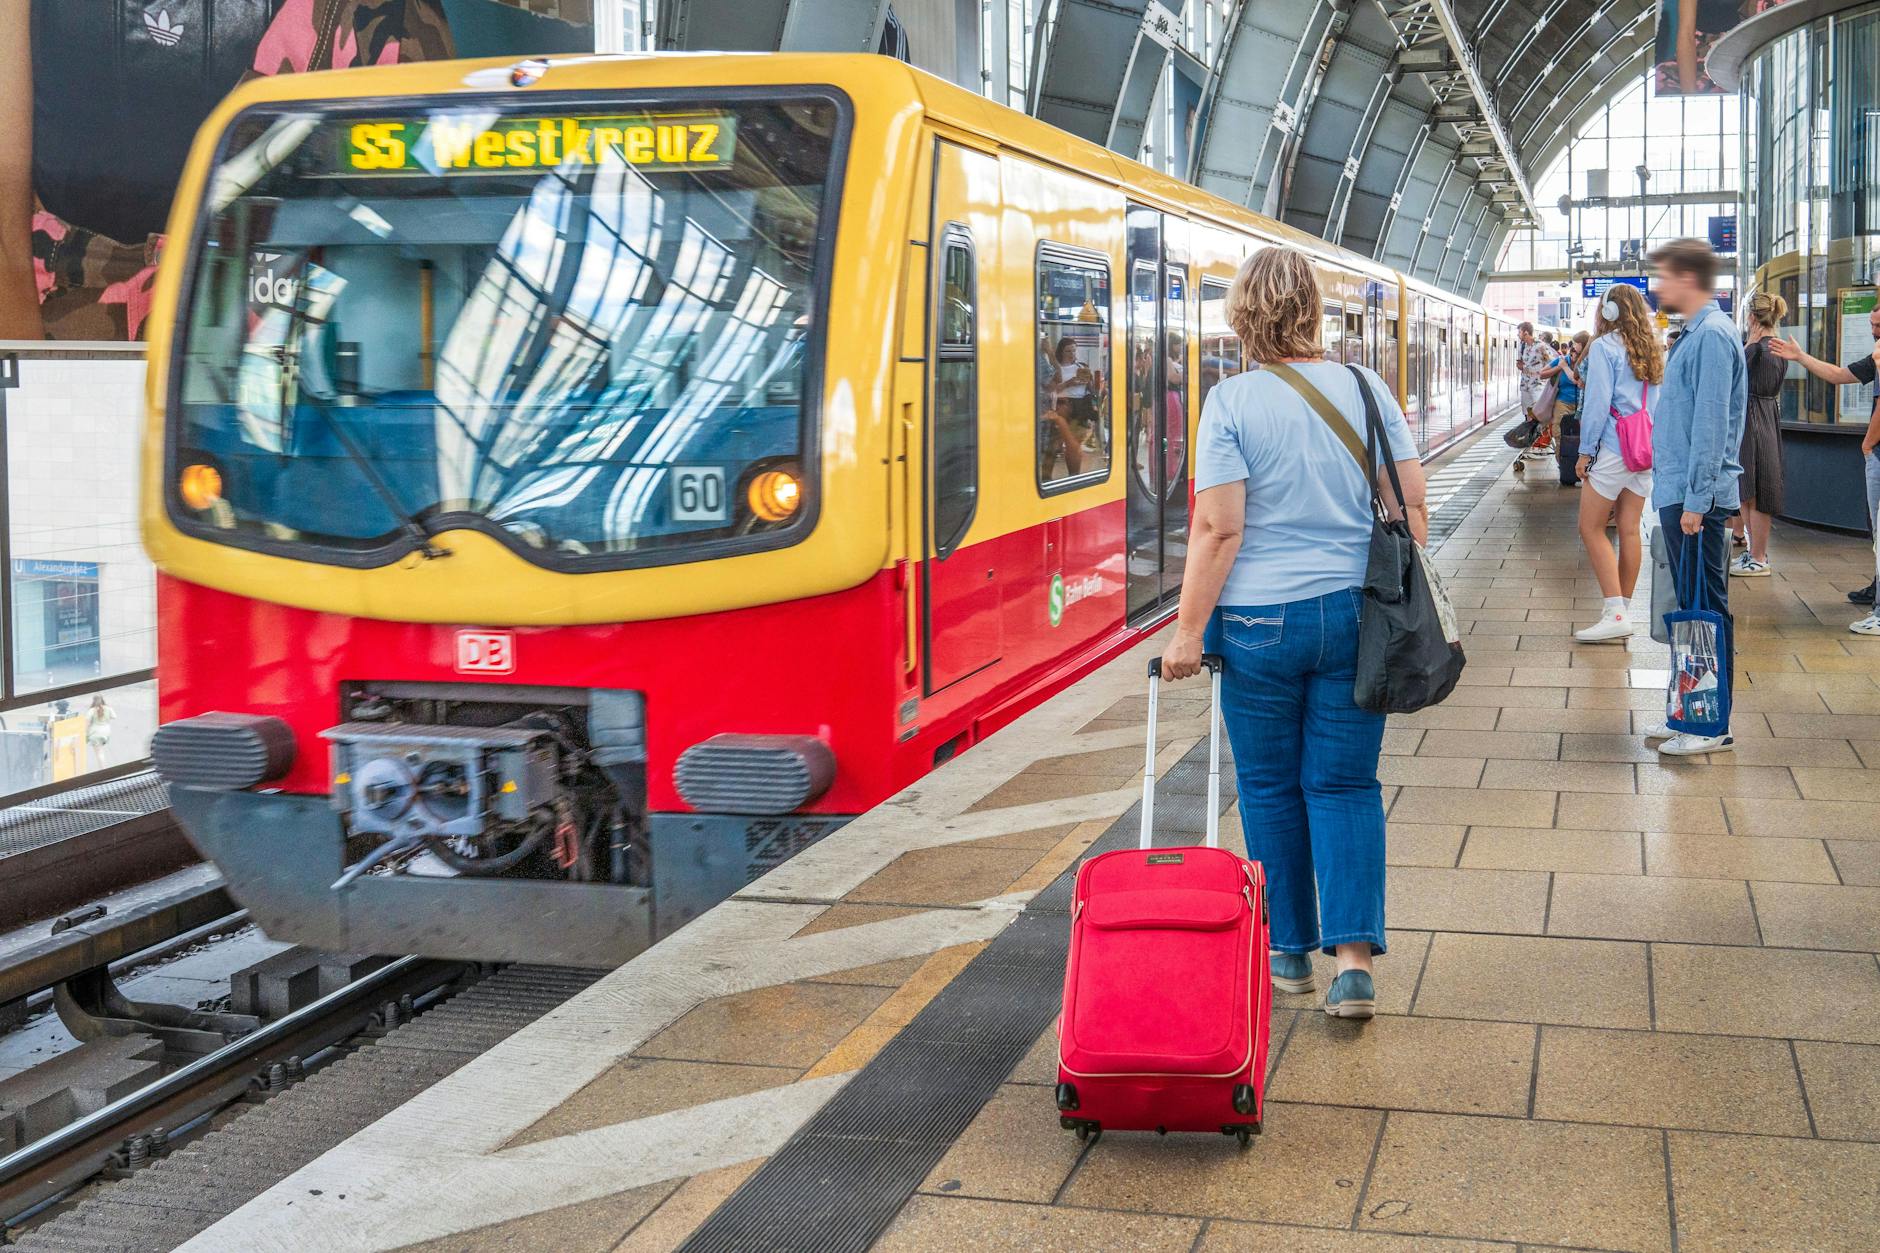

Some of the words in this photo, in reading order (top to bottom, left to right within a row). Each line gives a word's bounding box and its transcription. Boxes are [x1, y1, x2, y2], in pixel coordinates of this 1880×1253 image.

[350, 122, 405, 169] S5
[431, 117, 720, 169] Westkreuz
[248, 268, 298, 306] ida
[679, 473, 720, 513] 60
[14, 559, 23, 573] U
[33, 561, 88, 575] Alexanderplatz
[460, 636, 509, 668] DB
